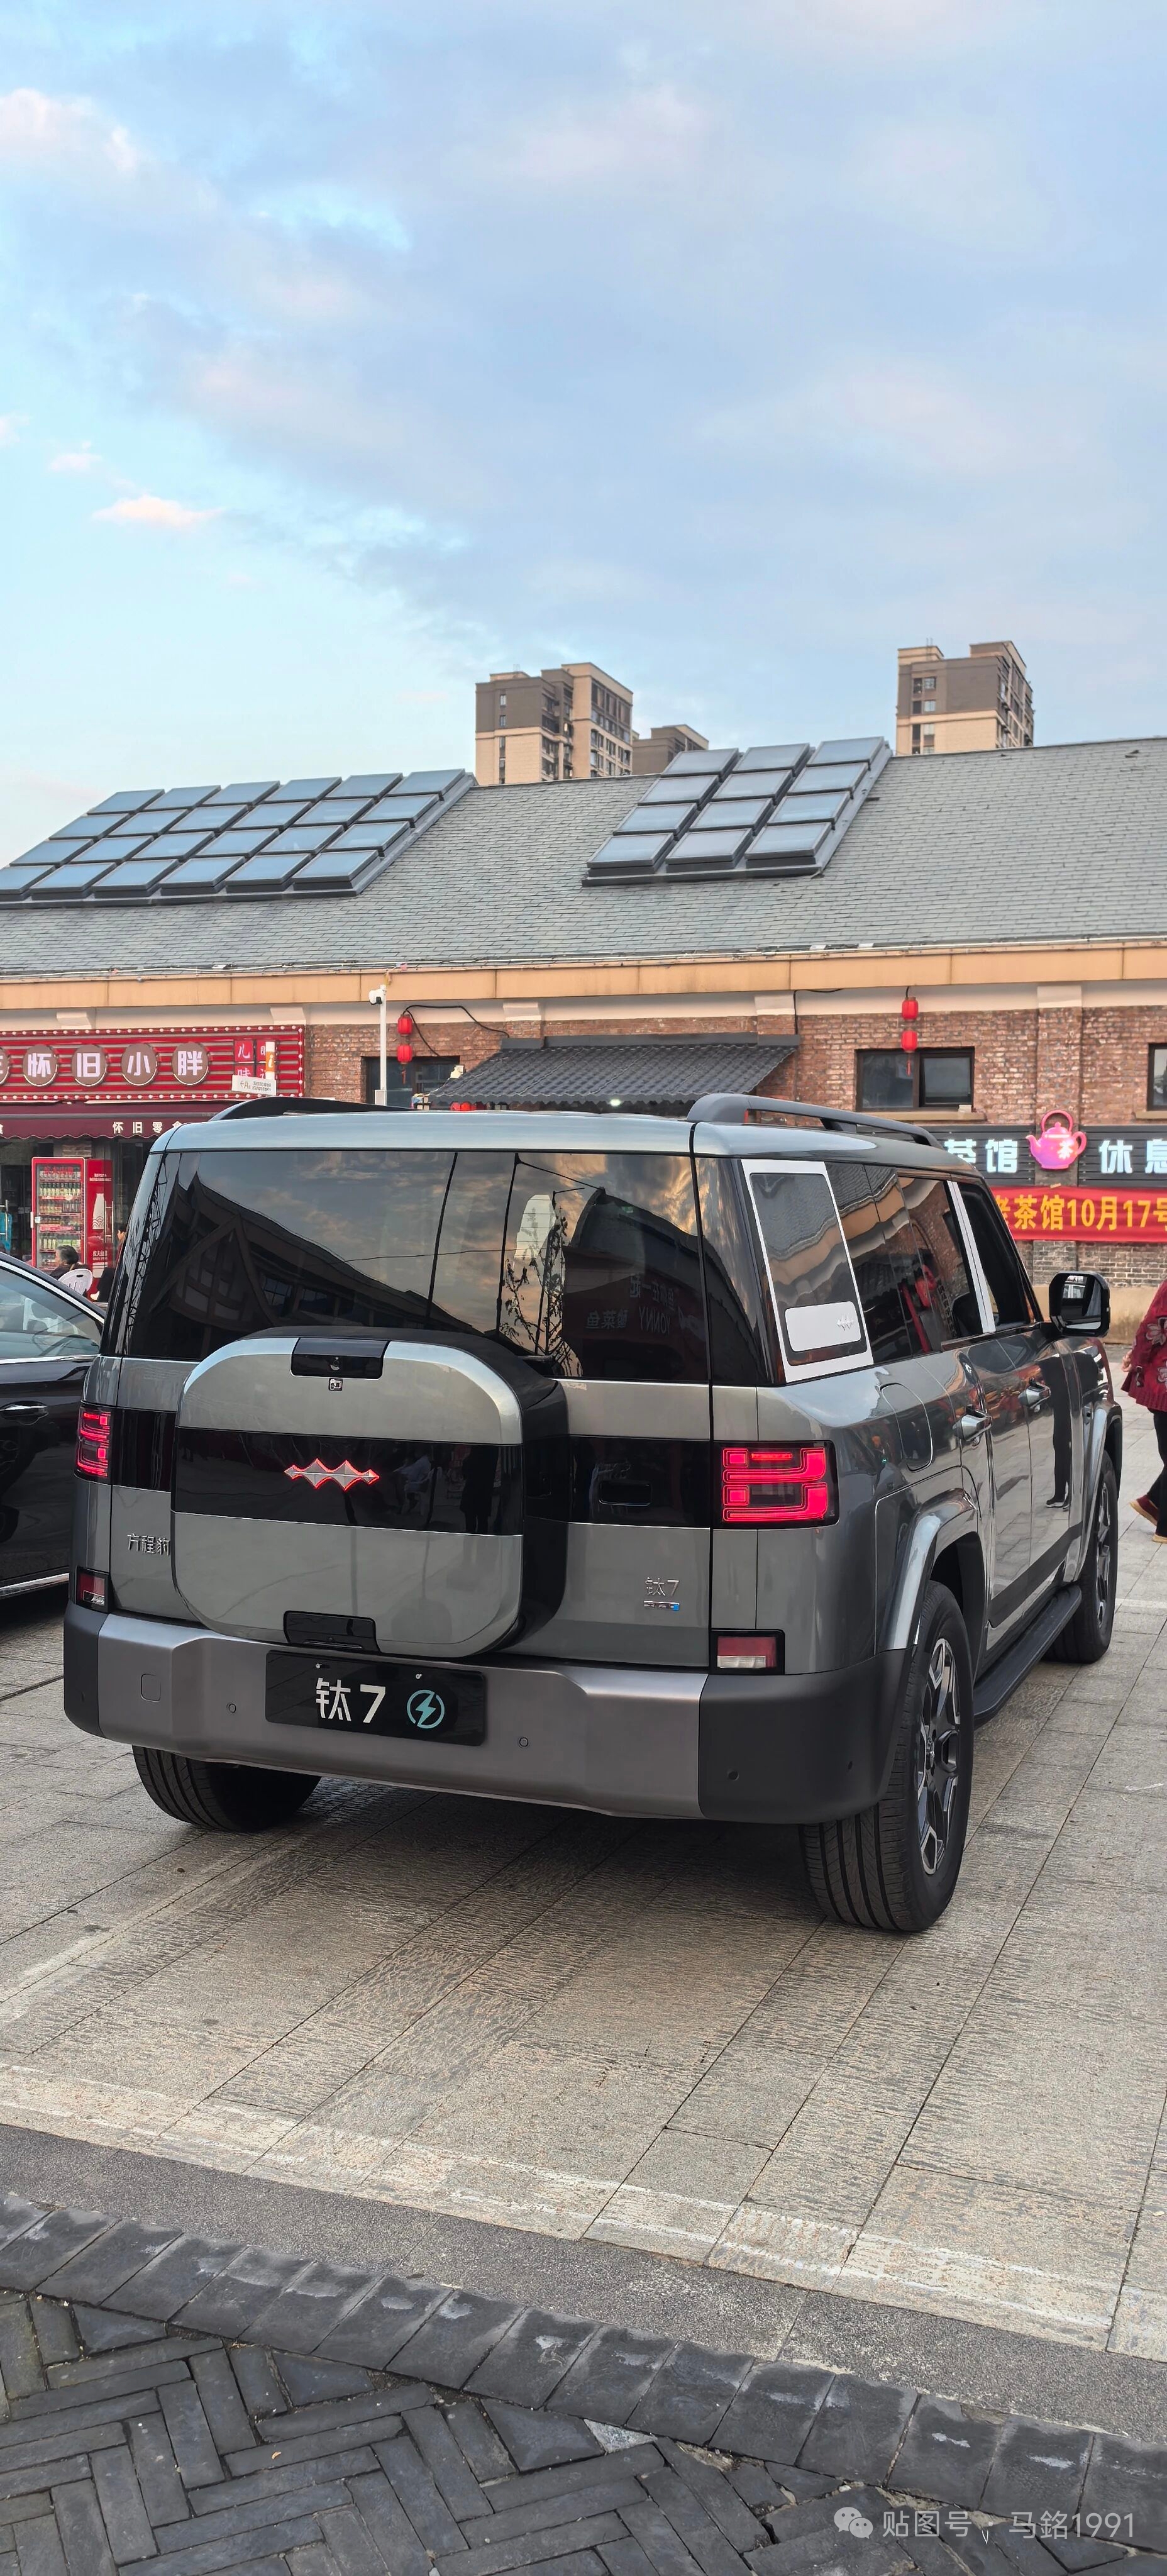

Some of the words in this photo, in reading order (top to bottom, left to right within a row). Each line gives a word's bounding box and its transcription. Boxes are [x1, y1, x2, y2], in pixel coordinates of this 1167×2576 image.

[0, 1050, 203, 1077] 怀旧小胖
[1057, 1140, 1074, 1160] 茶
[127, 1533, 170, 1557] 方程豹
[644, 1577, 680, 1597] 钛7
[316, 1677, 386, 1723] 钛7
